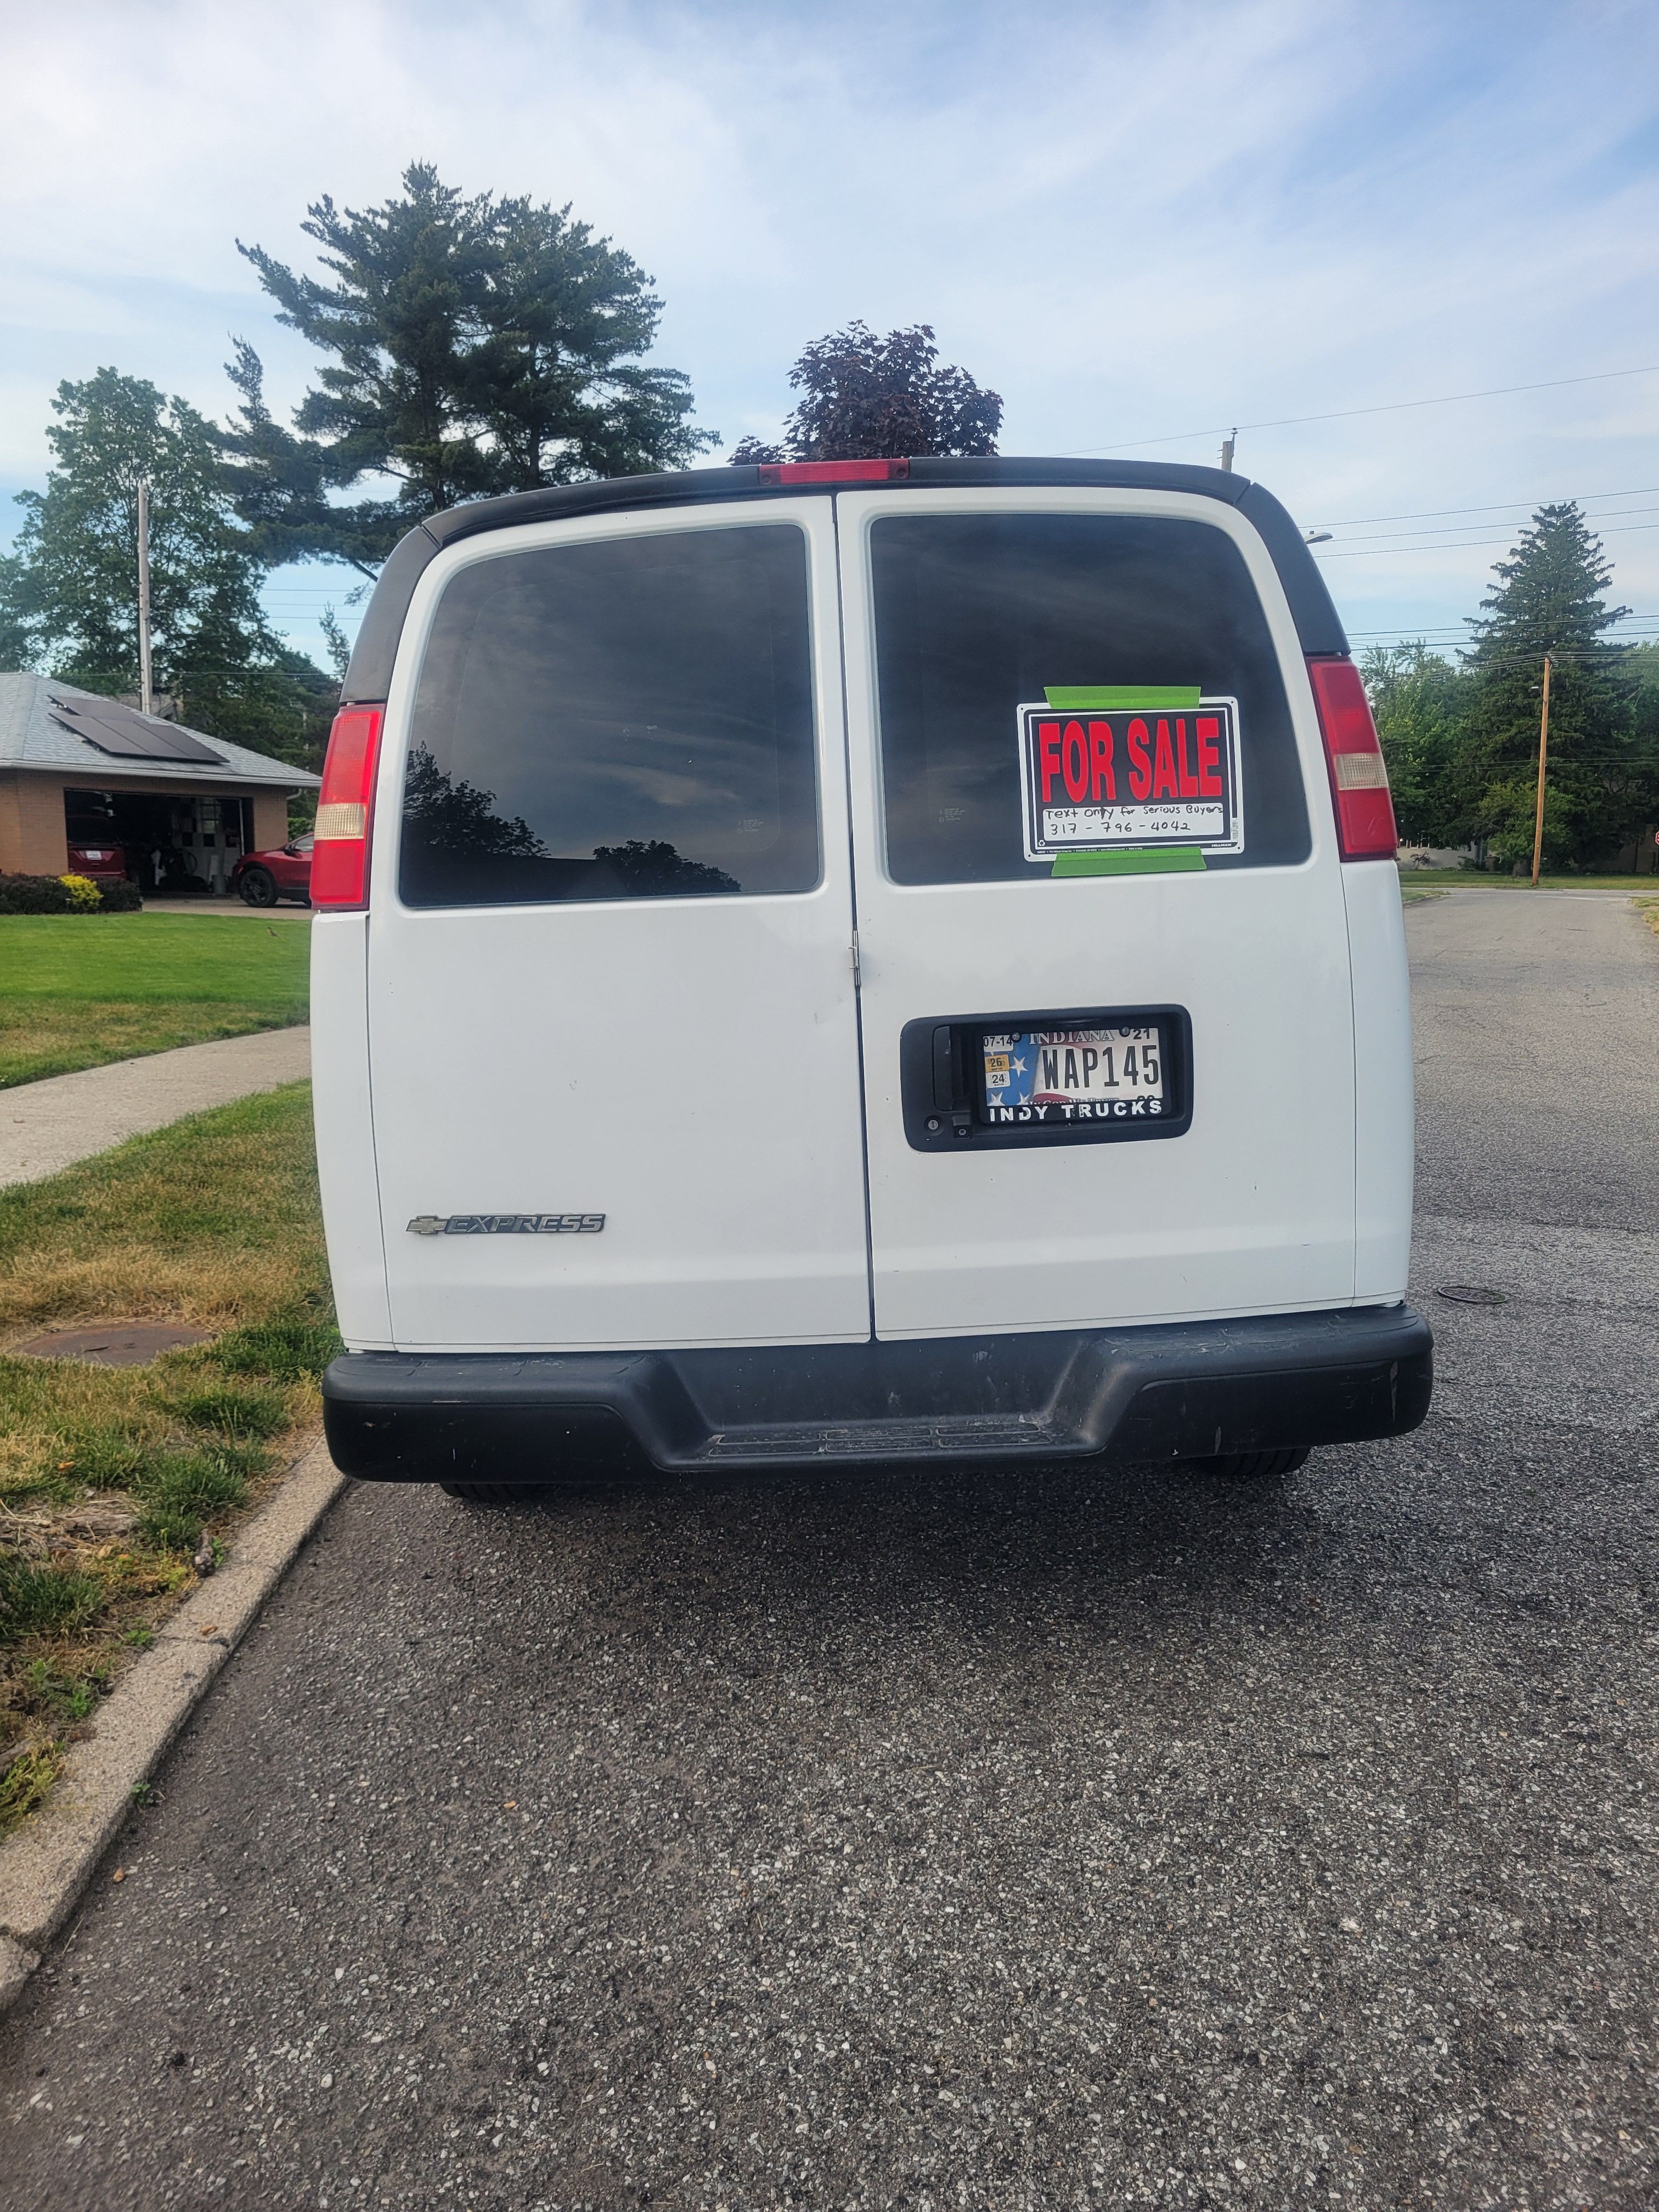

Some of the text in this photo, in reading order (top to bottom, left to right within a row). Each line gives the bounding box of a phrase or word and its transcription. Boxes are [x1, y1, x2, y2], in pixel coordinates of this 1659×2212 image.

[1039, 718, 1222, 803] FOR SALE
[1045, 809, 1079, 820] Text
[1120, 807, 1136, 817] for
[1186, 805, 1223, 816] Buyers
[1050, 823, 1077, 835] 317
[1101, 822, 1133, 833] 796
[1151, 821, 1191, 832] 4042
[984, 1036, 1012, 1047] 07-14
[1029, 1030, 1114, 1045] INDIANA
[1133, 1029, 1150, 1040] 21
[990, 1057, 1002, 1068] 26
[1044, 1045, 1158, 1090] WAP145
[992, 1074, 1005, 1084] 24
[990, 1101, 1162, 1121] INDY TRUCKS
[450, 1215, 603, 1233] EXPRESS
